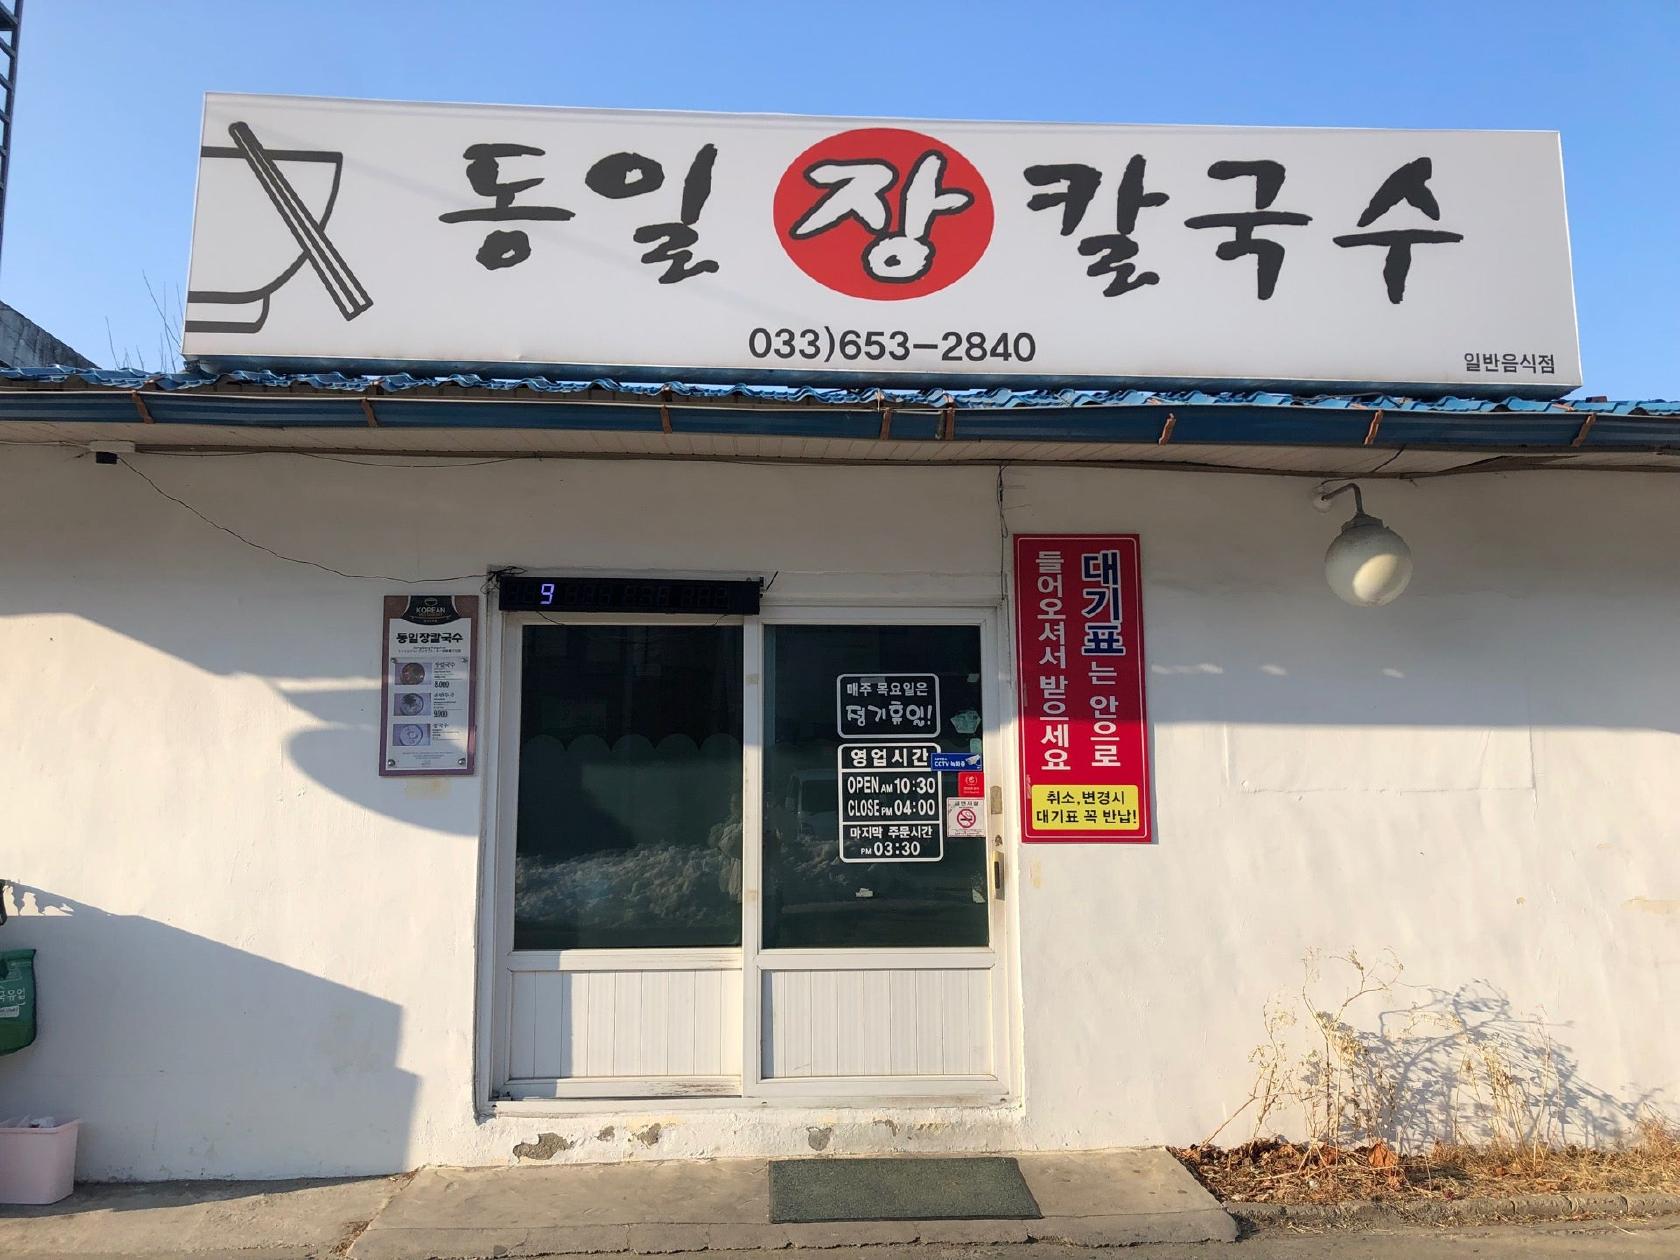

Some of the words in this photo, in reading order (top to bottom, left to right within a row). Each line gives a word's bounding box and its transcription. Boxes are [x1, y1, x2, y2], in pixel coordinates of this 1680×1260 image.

[439, 142, 1464, 304] 동일장칼국수
[748, 326, 1036, 362] 033)653-2840
[1464, 353, 1555, 374] 일반음식점
[540, 583, 554, 605] 9
[416, 606, 446, 614] KOREAN
[1035, 551, 1067, 669] 들어오셔서
[396, 632, 464, 644] 동일장칼국수
[846, 682, 872, 697] 매주
[876, 682, 928, 697] 목요일은
[846, 701, 932, 727] 정기휴일!
[1039, 675, 1072, 771] 받으세요
[1089, 695, 1121, 767] 안으로
[850, 748, 929, 767] 영업시간
[847, 776, 880, 794] OPEN
[881, 785, 893, 793] AM
[894, 777, 936, 794] 10:30
[848, 799, 880, 816] CLOSE
[881, 808, 893, 816] PM
[894, 799, 936, 815] 04:00
[1036, 809, 1079, 824] 대기표
[1083, 809, 1098, 824] 꼭
[1102, 808, 1137, 824] 반납!
[850, 826, 883, 839] 마지막
[887, 825, 933, 839] 주문시간
[873, 841, 921, 856] 03:30
